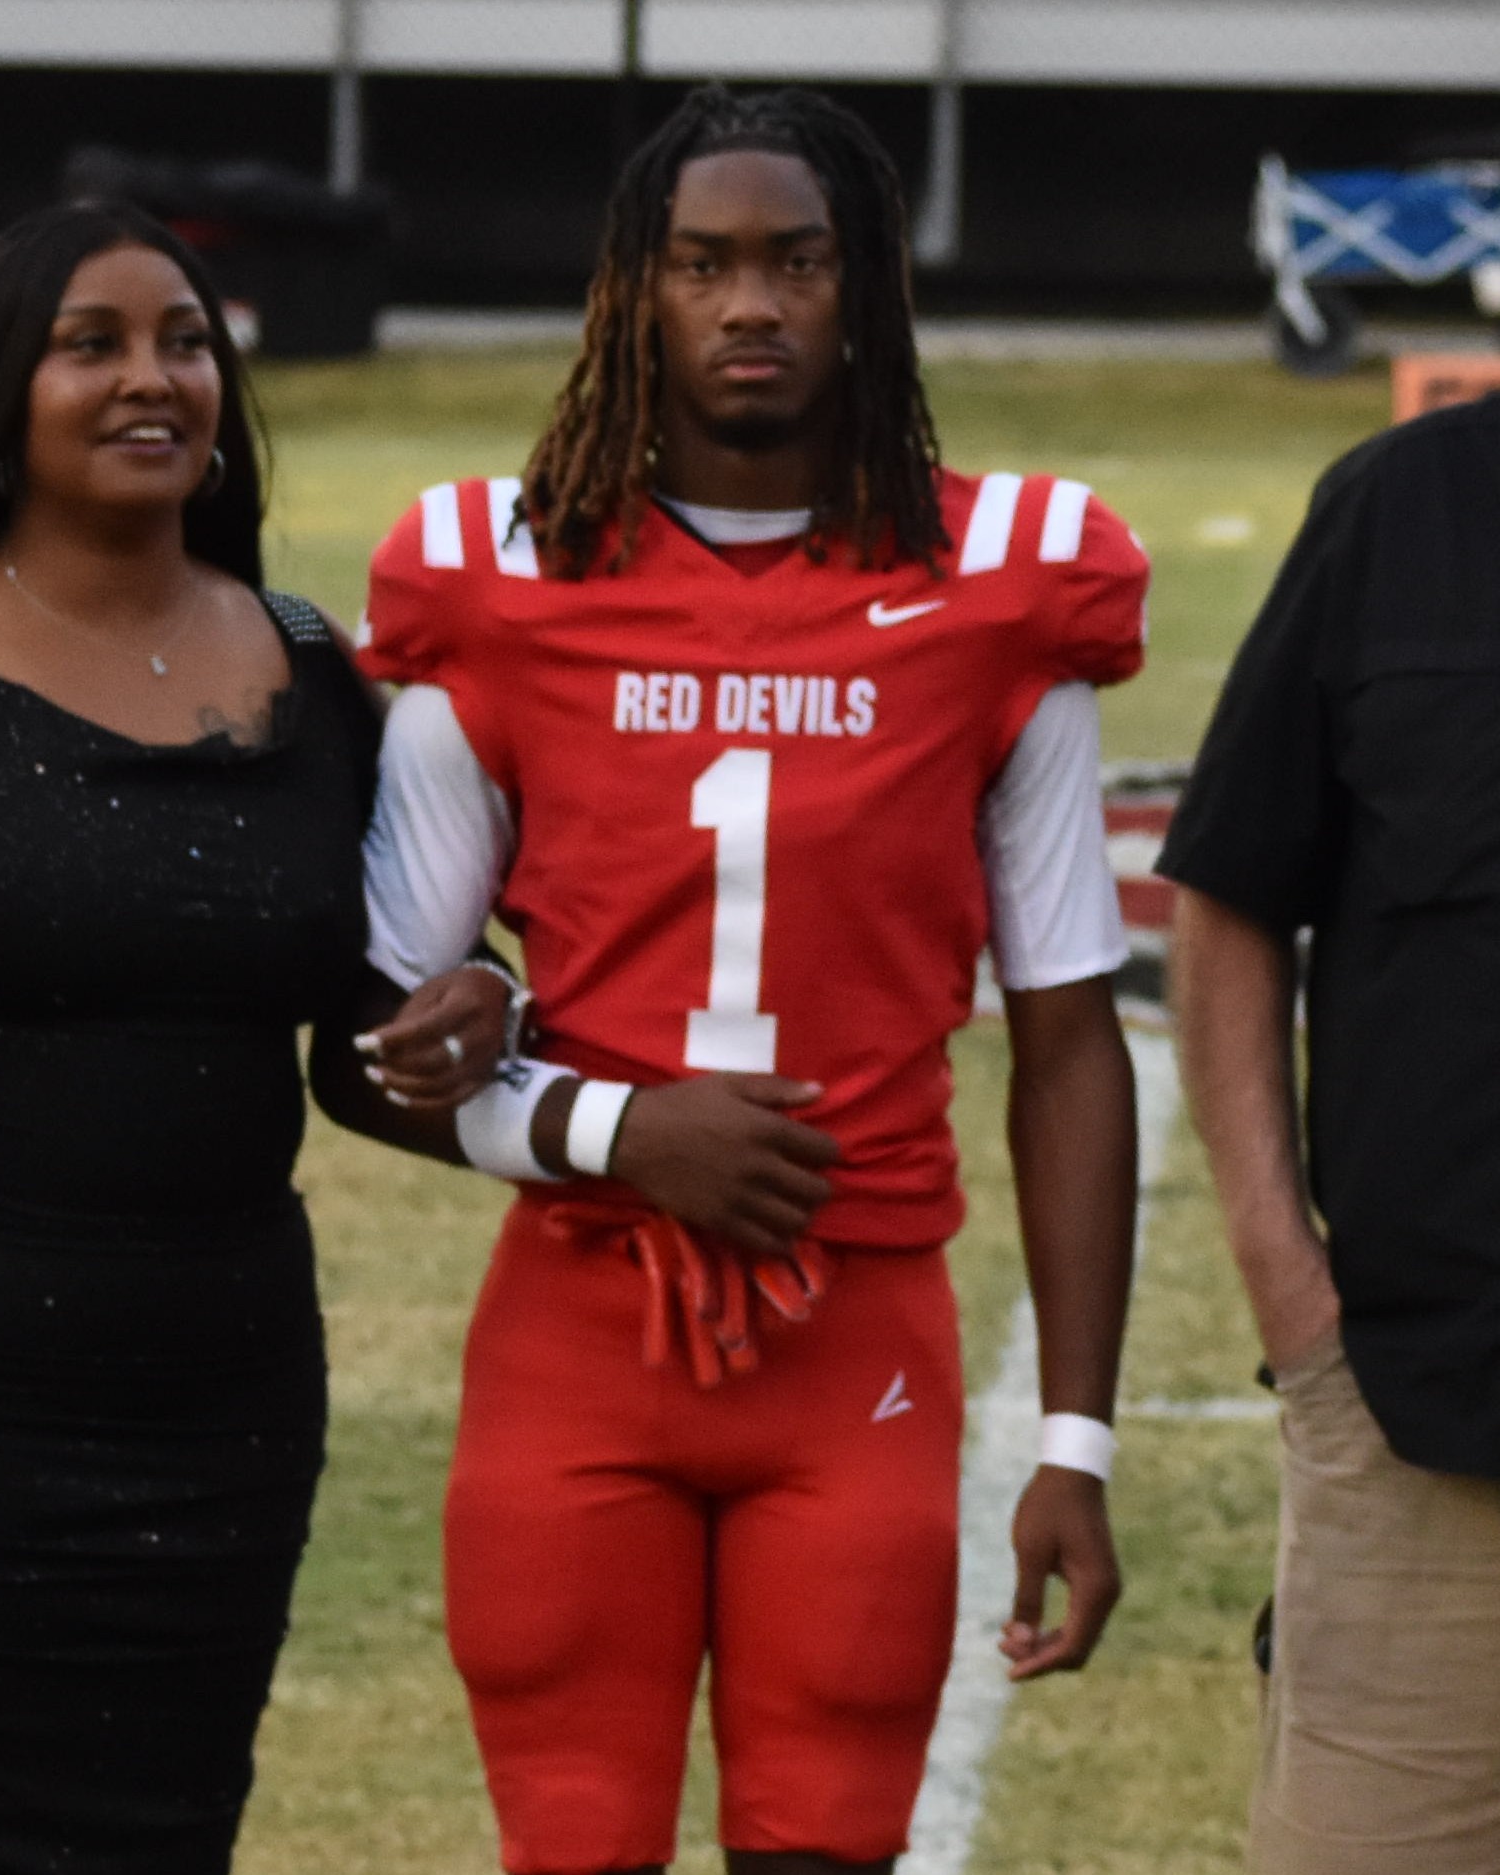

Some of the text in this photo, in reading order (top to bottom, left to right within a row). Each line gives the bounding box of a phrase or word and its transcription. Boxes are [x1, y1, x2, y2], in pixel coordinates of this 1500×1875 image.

[613, 672, 877, 736] RED DEVILS
[684, 748, 778, 1073] 1
